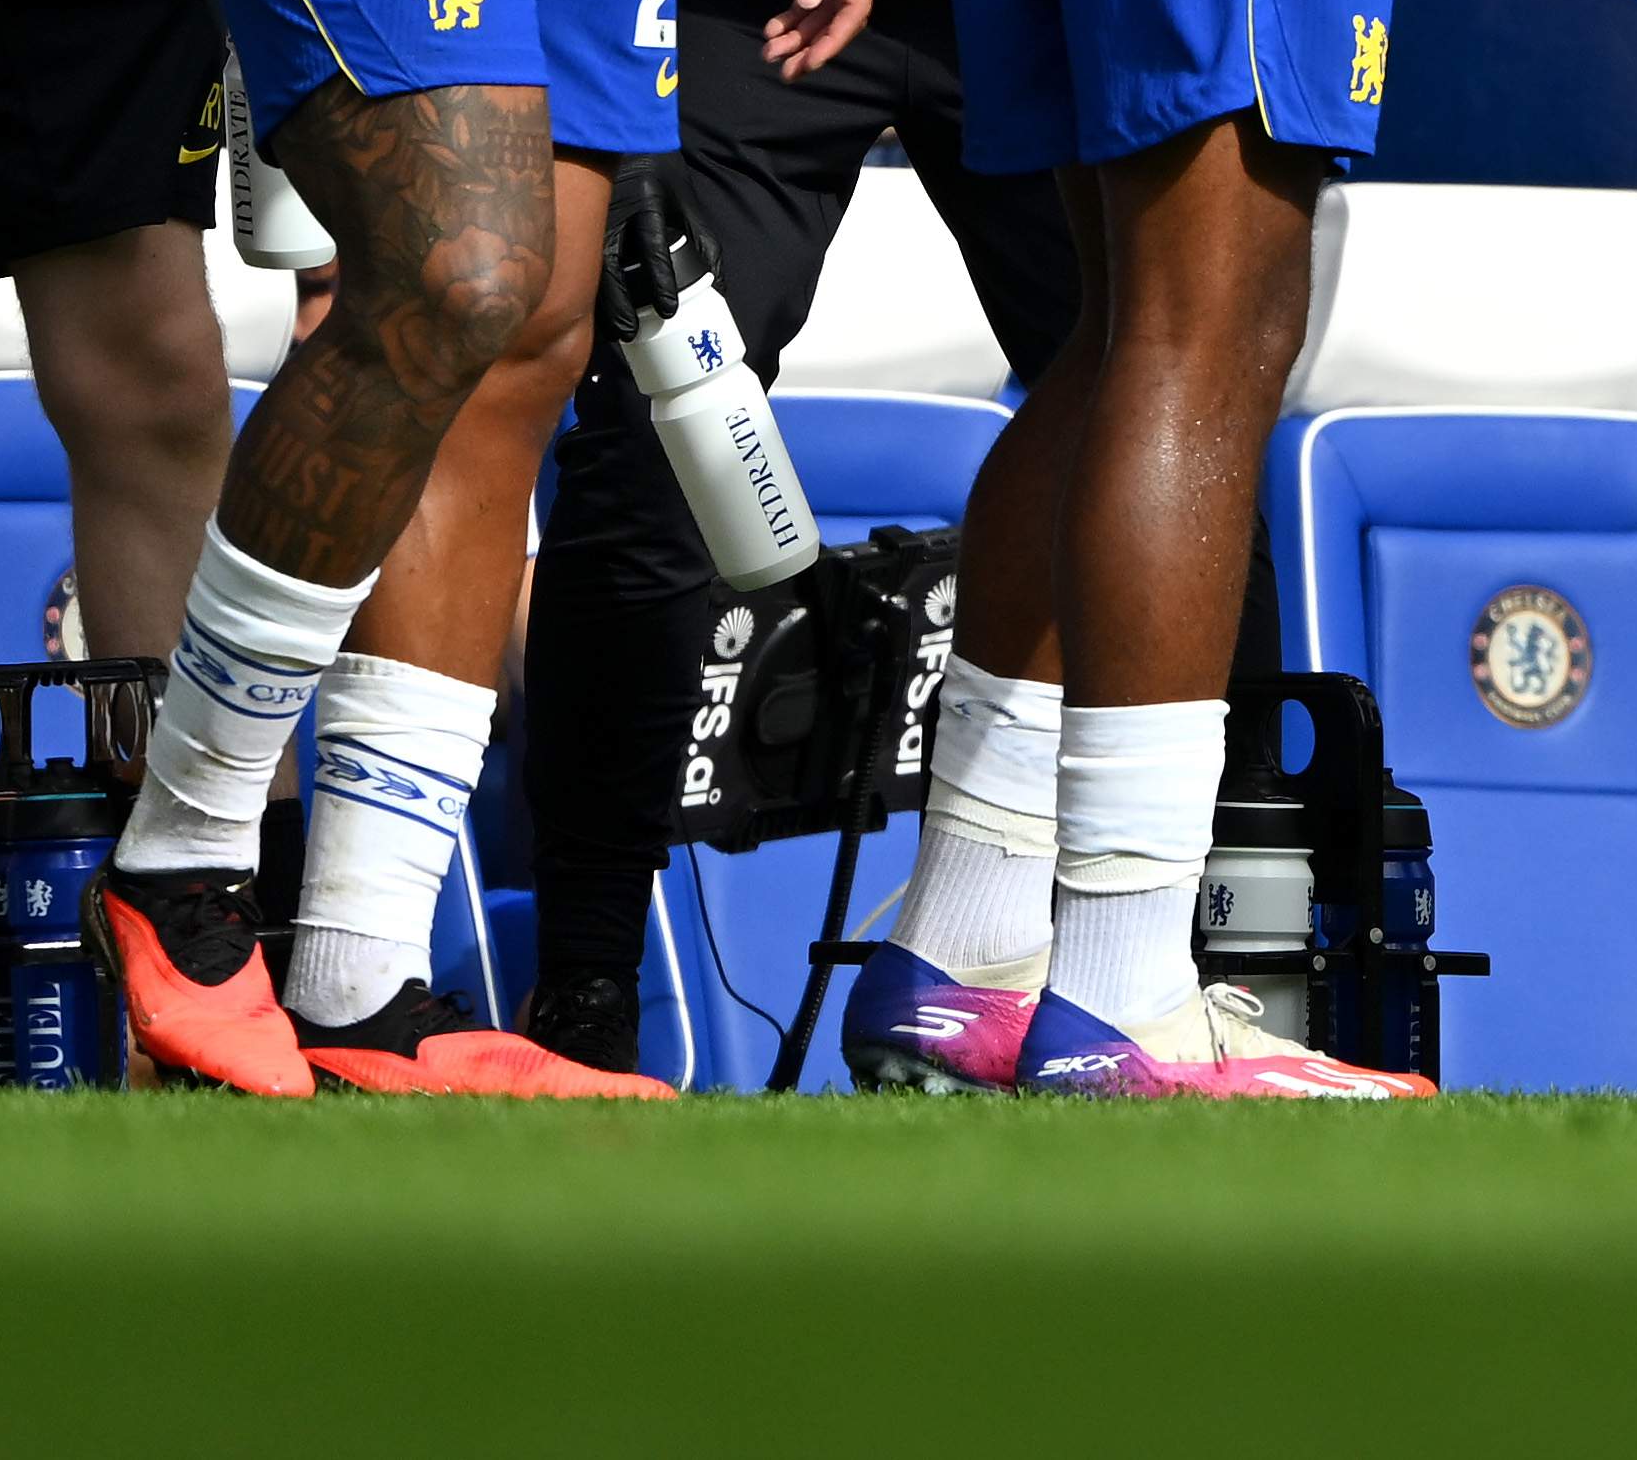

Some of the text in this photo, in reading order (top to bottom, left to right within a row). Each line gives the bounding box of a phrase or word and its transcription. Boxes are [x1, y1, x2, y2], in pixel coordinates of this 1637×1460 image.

[233, 86, 250, 241] HYDRATE
[725, 406, 800, 549] HYDRATE
[681, 662, 743, 809] IFS.ai
[1036, 1053, 1131, 1078] SKX
